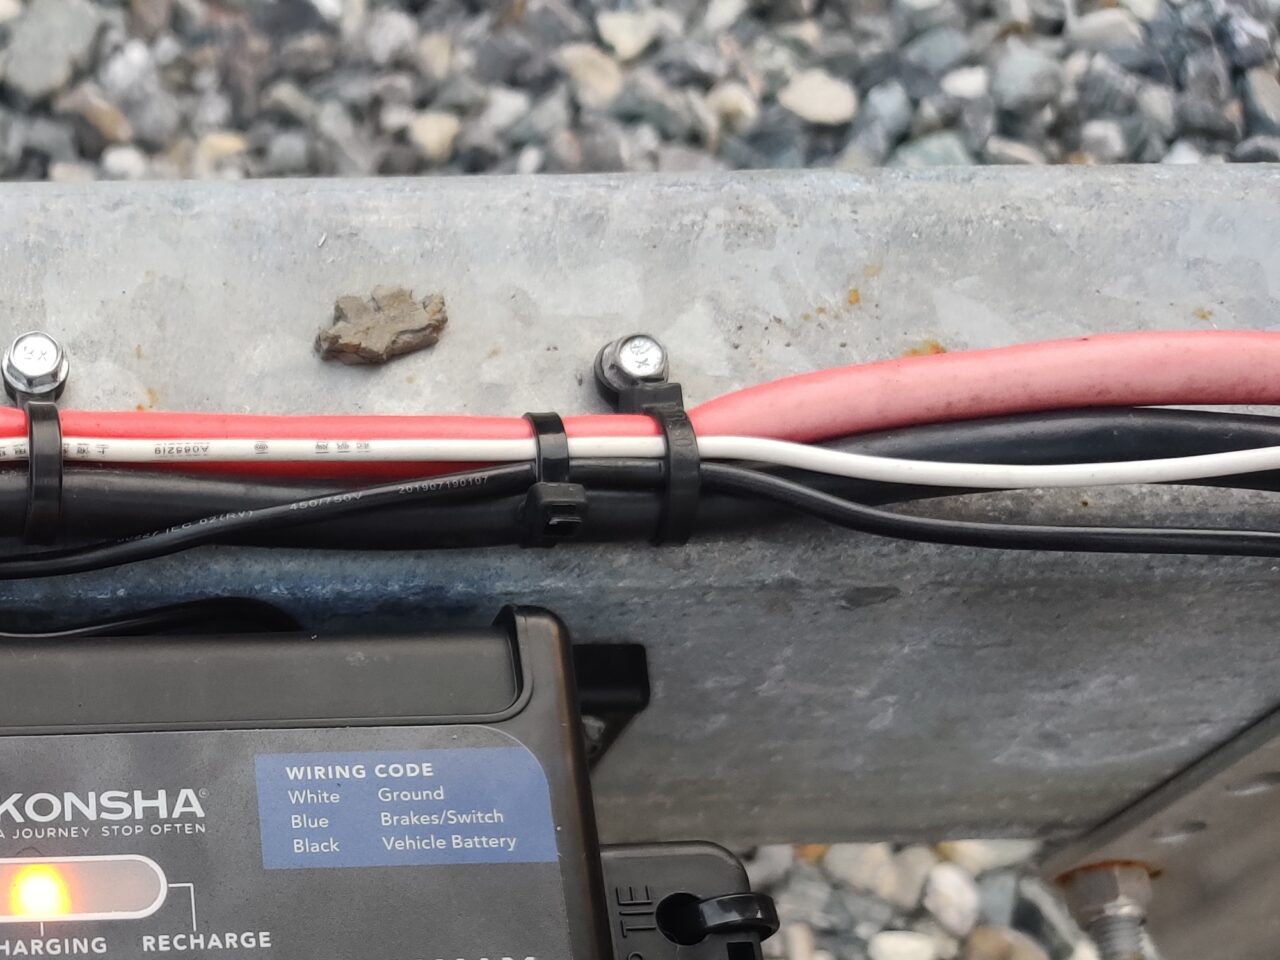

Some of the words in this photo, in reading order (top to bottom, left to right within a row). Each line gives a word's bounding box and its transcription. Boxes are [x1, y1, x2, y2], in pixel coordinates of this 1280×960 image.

[285, 764, 367, 781] WIRING
[374, 762, 435, 778] CODE
[288, 789, 340, 805] White
[378, 785, 445, 802] Ground
[291, 814, 329, 829] Blue
[380, 809, 504, 827] Brakes/Switch
[12, 827, 91, 840] JOURNEY
[101, 825, 144, 838] STOP
[150, 823, 206, 836] OFTEN
[293, 838, 340, 853] Black
[382, 835, 447, 851] Vehicle
[451, 834, 517, 852] Battery
[615, 885, 658, 938] TIE
[142, 931, 272, 952] RECHARGE
